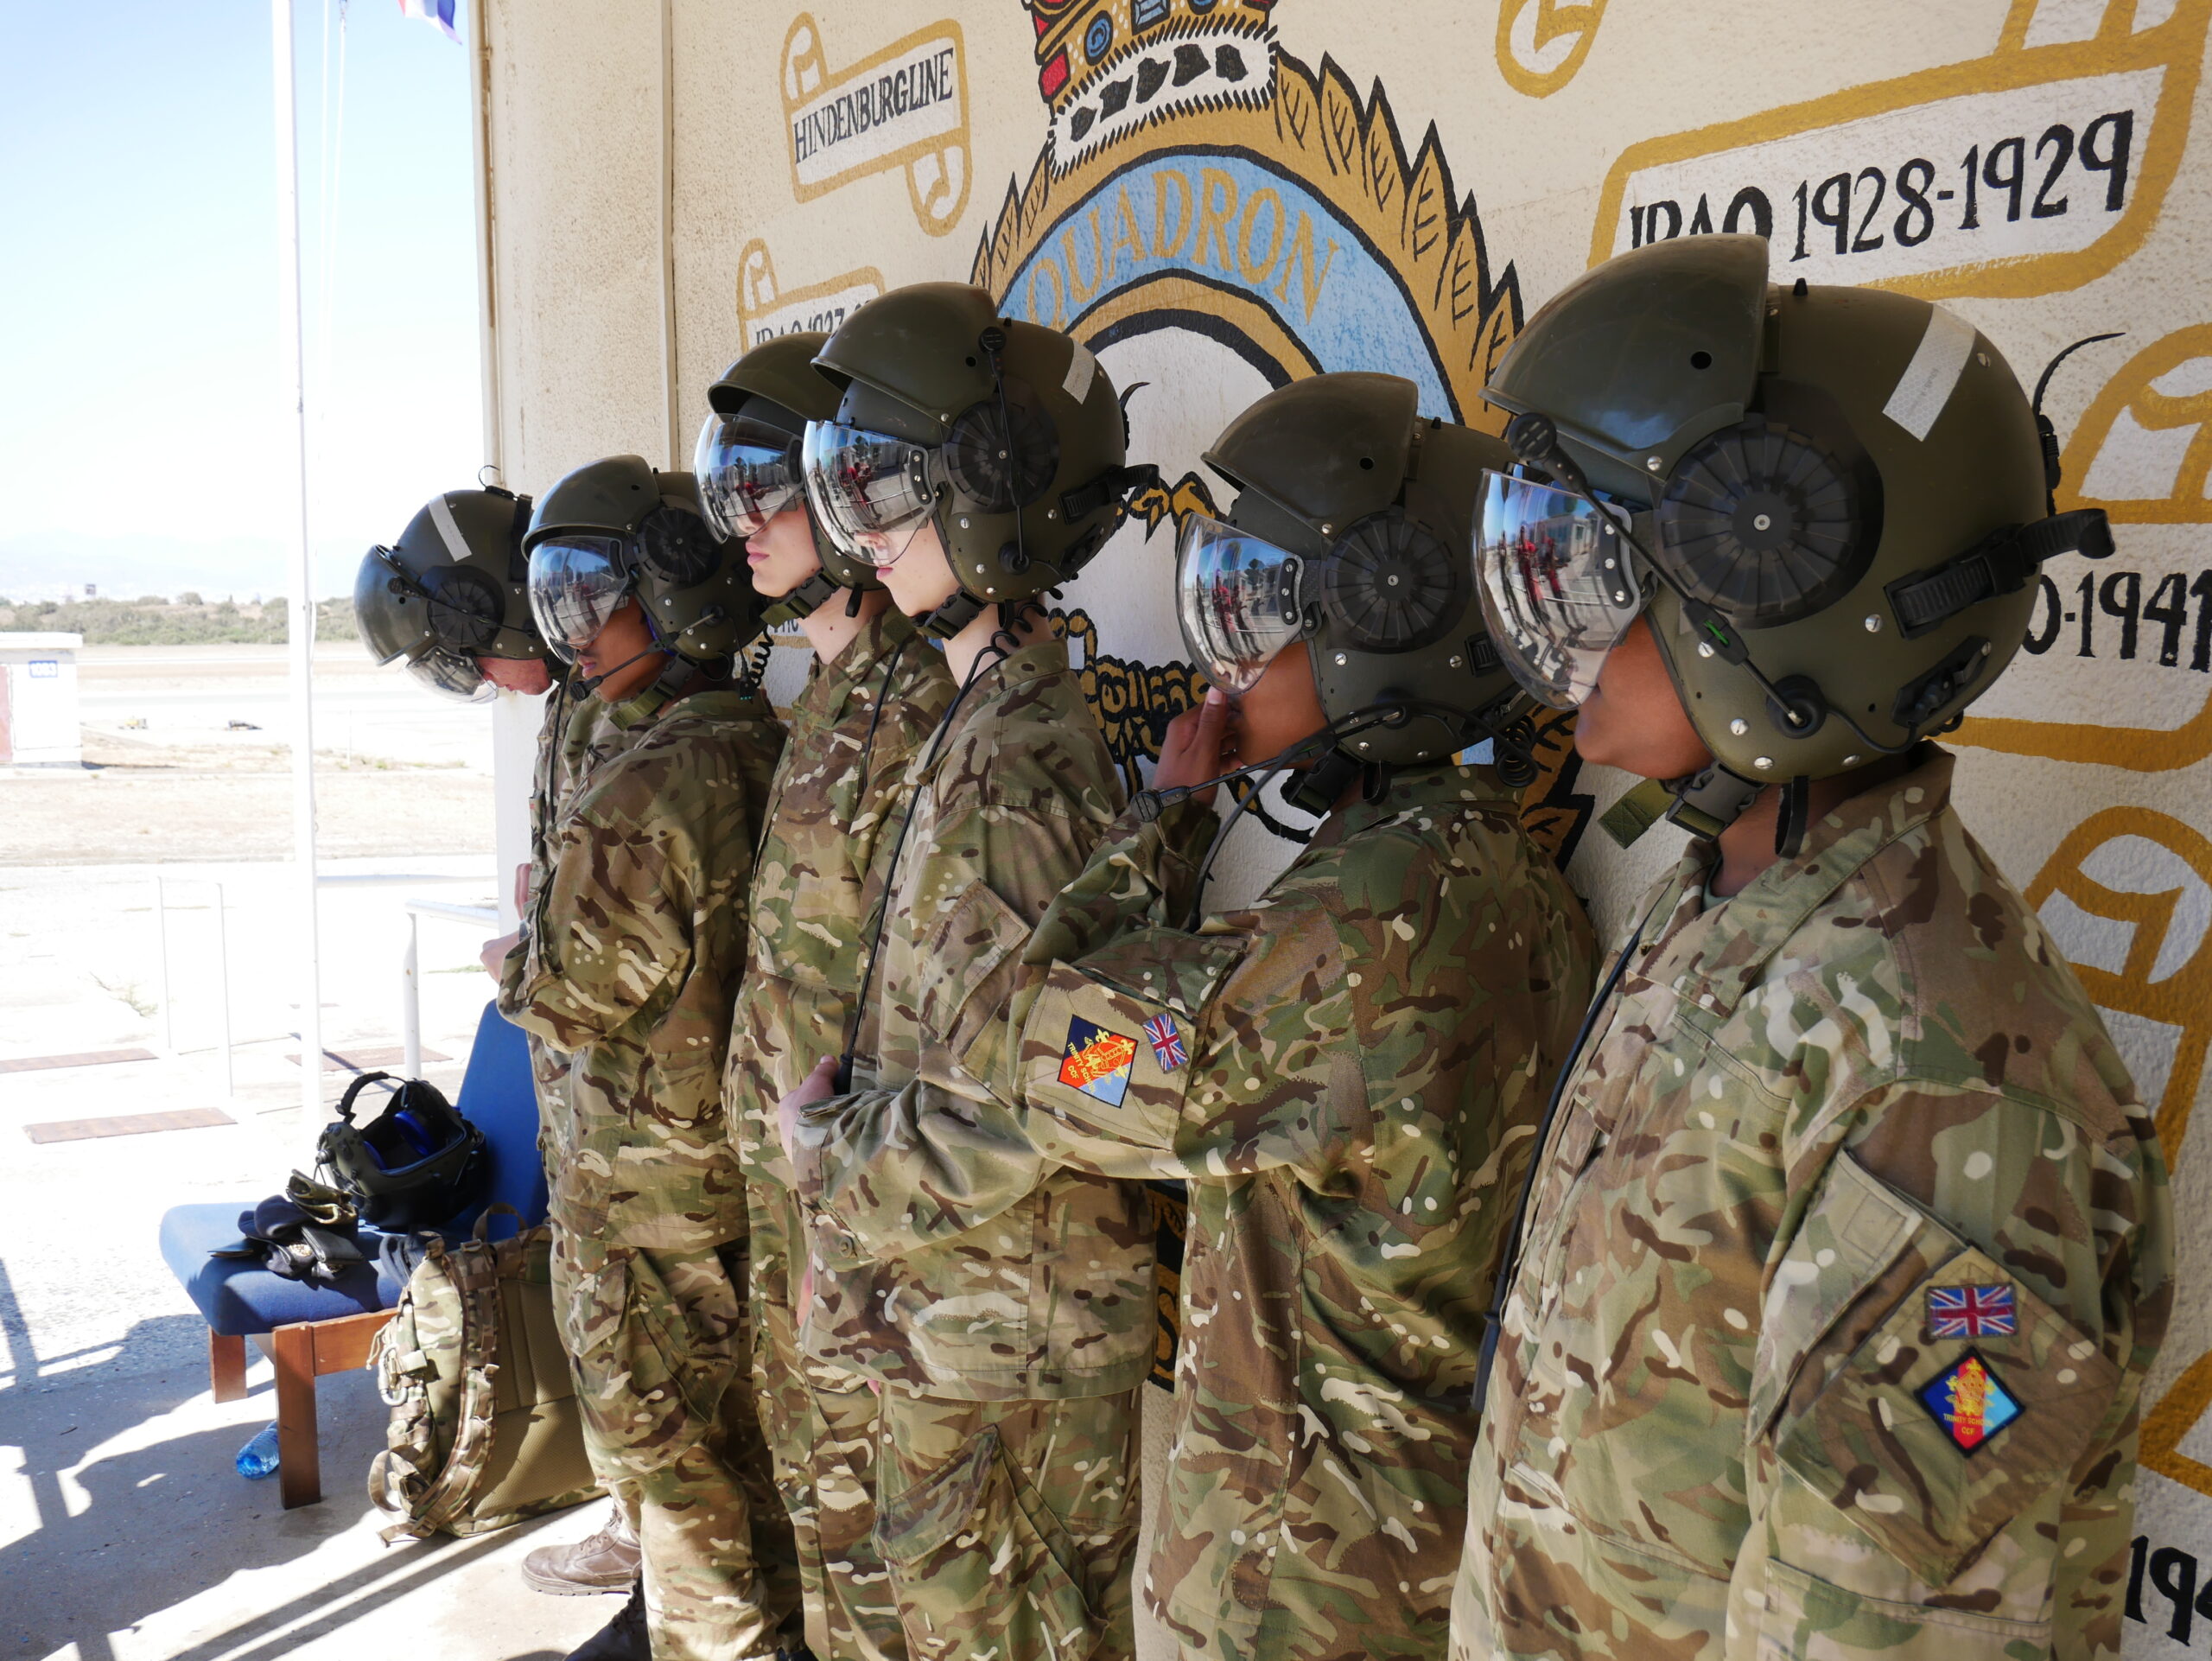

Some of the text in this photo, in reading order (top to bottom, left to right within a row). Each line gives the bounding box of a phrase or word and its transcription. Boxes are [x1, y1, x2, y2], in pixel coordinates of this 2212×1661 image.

[1789, 109, 2134, 263] 1928-1929
[1026, 167, 1341, 331] QUADRON
[1067, 1041, 1084, 1067] TRINITY
[1067, 1065, 1080, 1079] CCF
